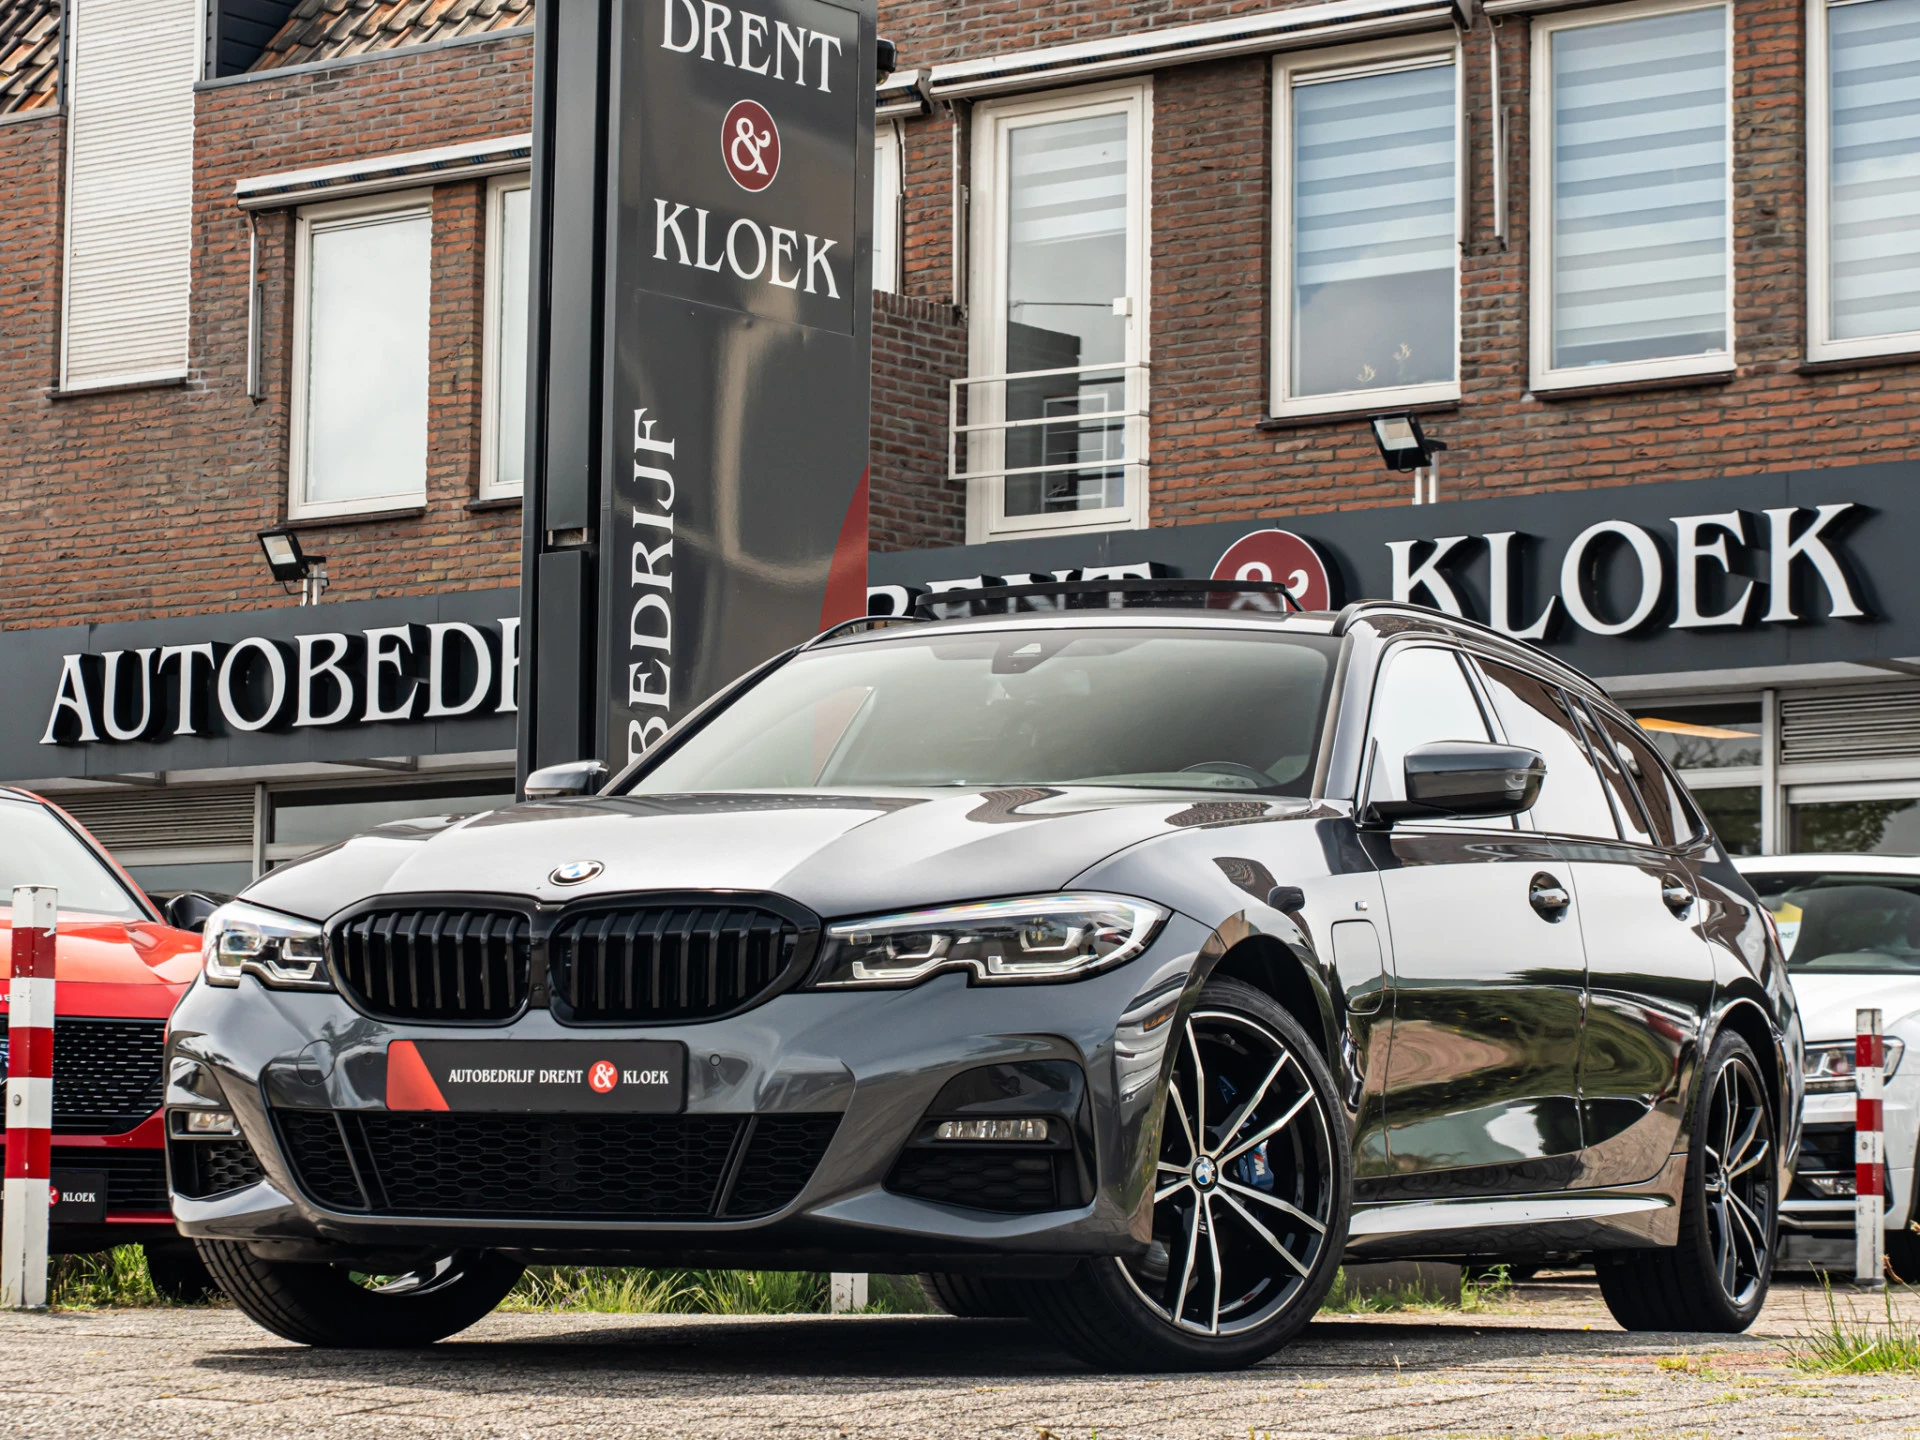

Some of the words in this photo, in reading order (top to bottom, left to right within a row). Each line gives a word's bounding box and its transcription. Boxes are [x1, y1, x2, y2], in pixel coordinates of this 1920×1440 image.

[660, 0, 842, 93] DRENT
[731, 117, 771, 175] &
[652, 198, 841, 299] KLOEK
[1385, 502, 1865, 641] KLOEK
[448, 1069, 535, 1083] AUTOBEDRIJF
[539, 1070, 583, 1084] DRENT
[593, 1063, 614, 1088] &
[623, 1070, 669, 1084] KLOEK
[62, 1191, 96, 1202] KLOEK
